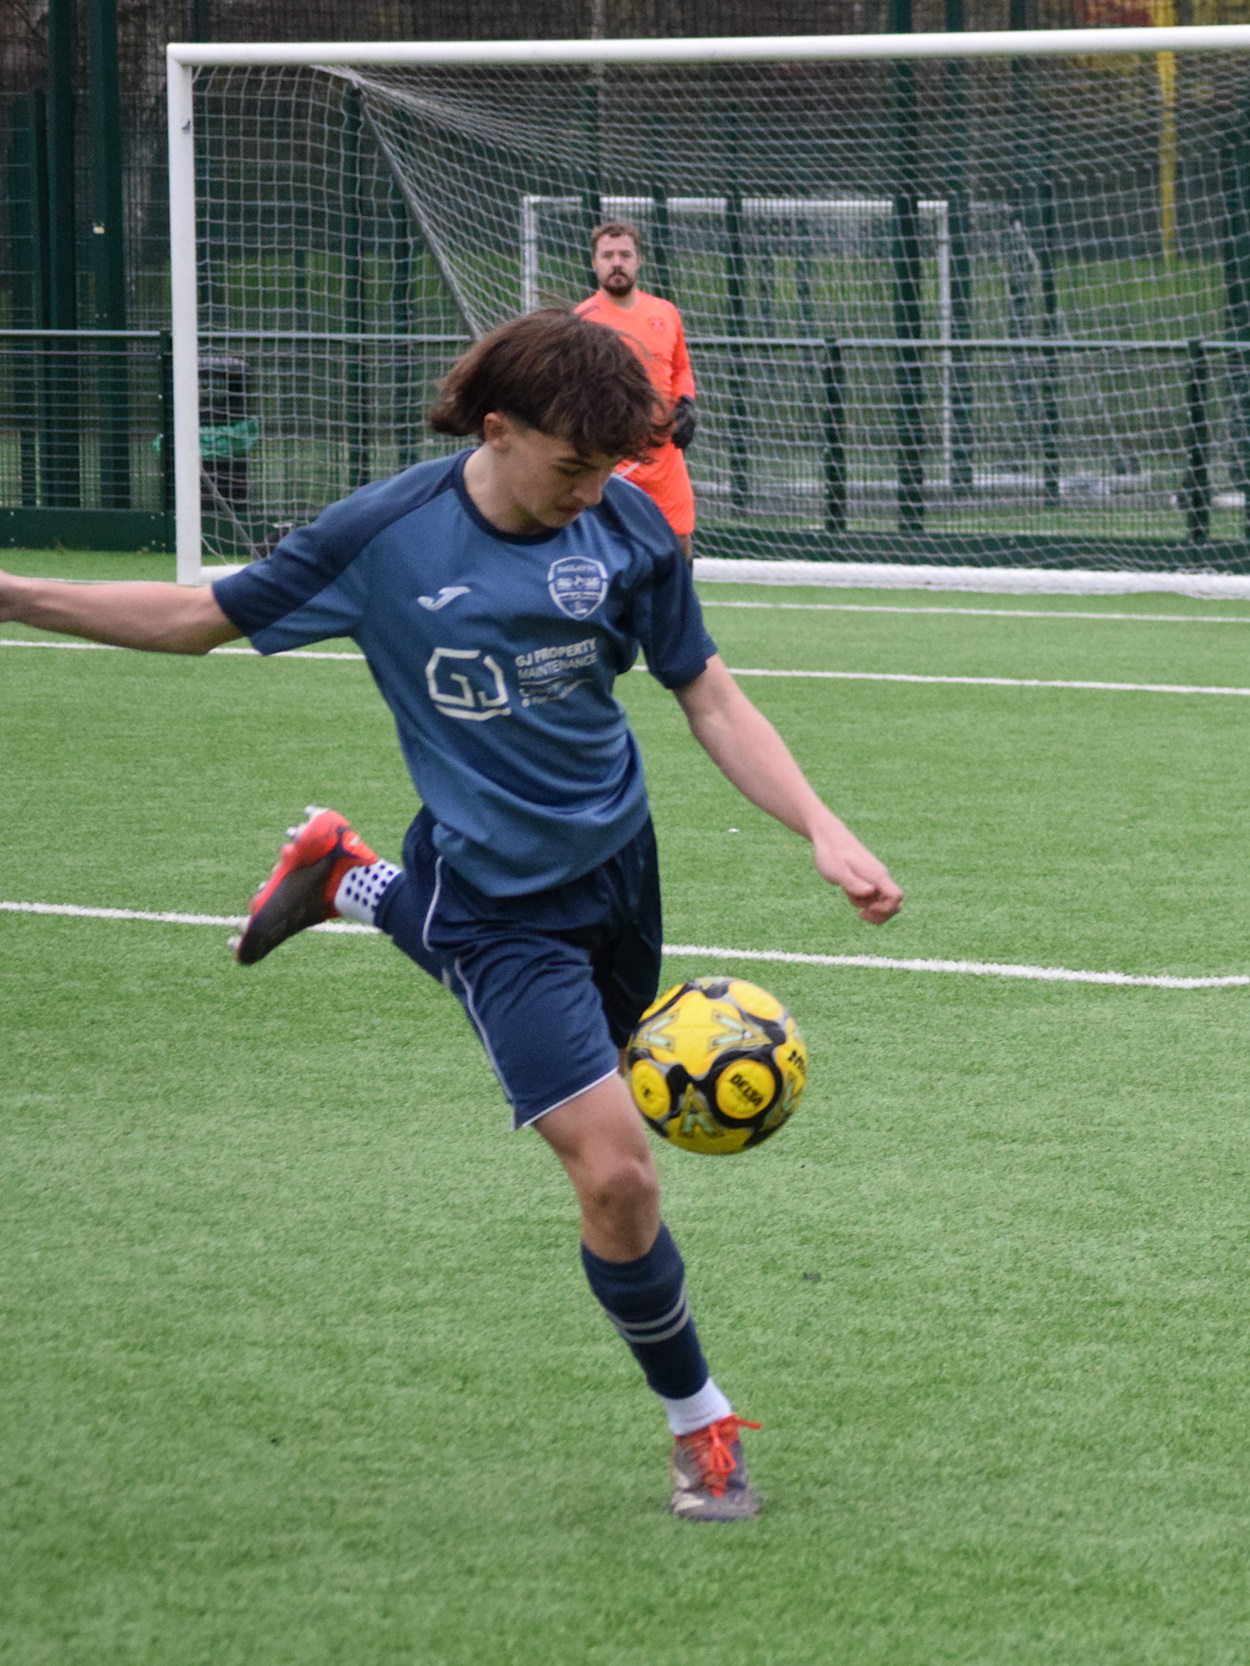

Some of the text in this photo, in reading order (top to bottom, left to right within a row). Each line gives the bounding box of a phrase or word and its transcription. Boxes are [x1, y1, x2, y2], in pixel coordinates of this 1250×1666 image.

[514, 637, 597, 667] GJ PROPERTY
[517, 651, 598, 680] MAINTENANCE
[729, 1073, 764, 1107] DELTA
